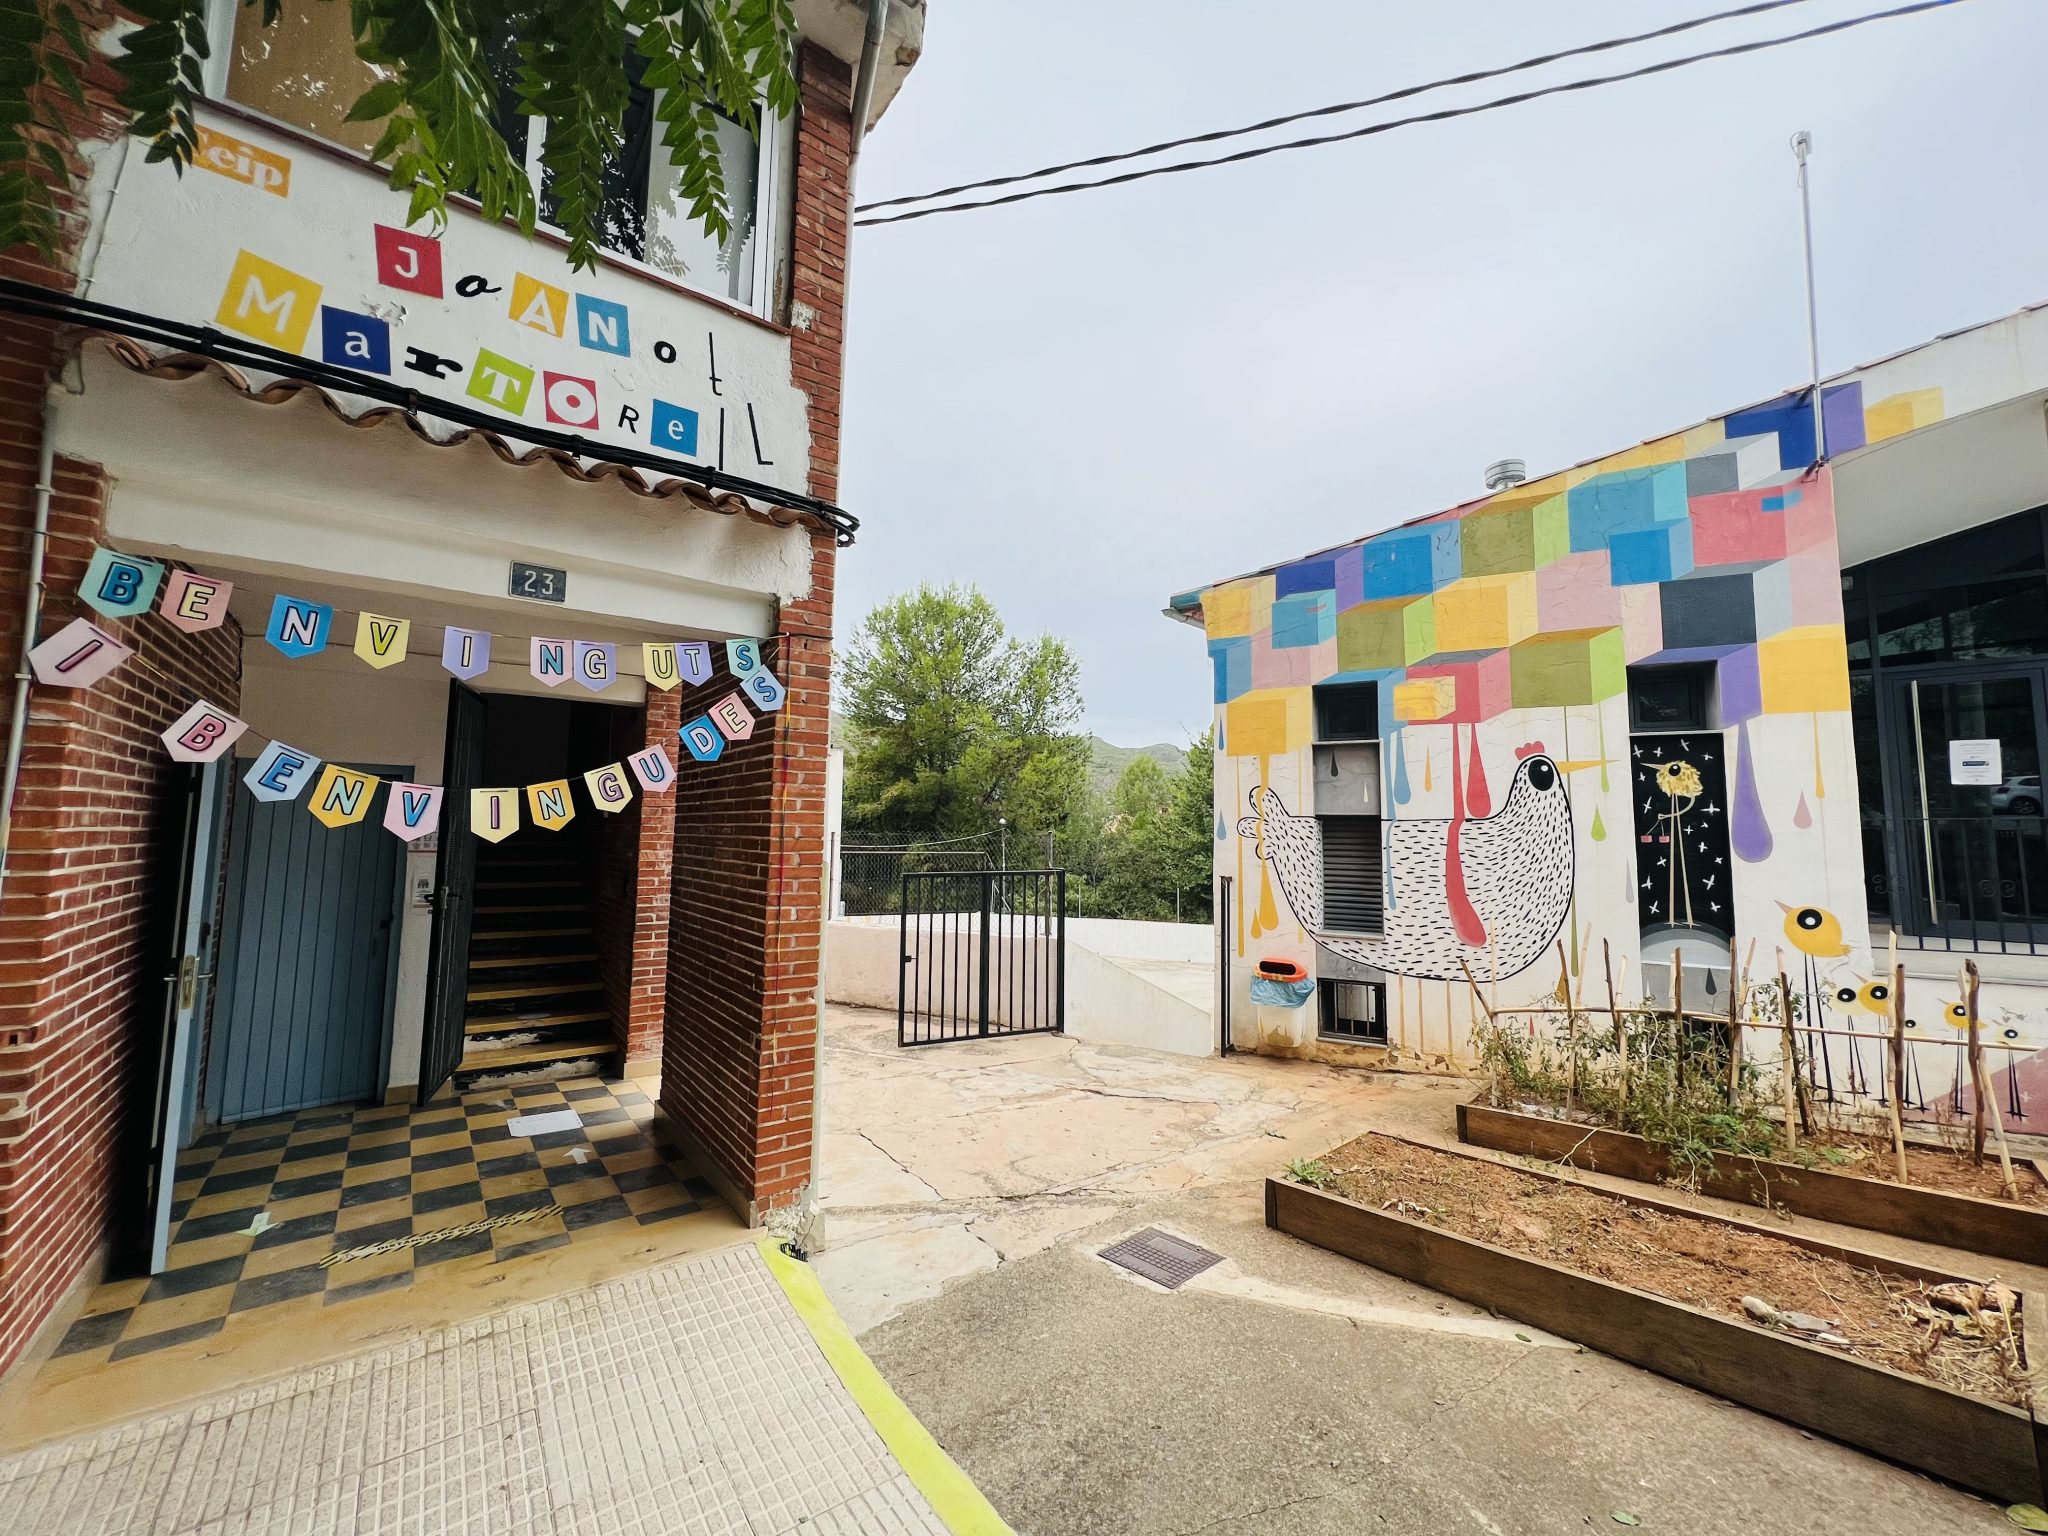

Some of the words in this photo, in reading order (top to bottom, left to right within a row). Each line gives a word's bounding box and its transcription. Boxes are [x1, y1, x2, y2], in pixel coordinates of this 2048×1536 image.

[97, 561, 754, 680] BENVINGUTS
[524, 570, 555, 595] 23
[178, 676, 777, 831] BENVINGUDES
